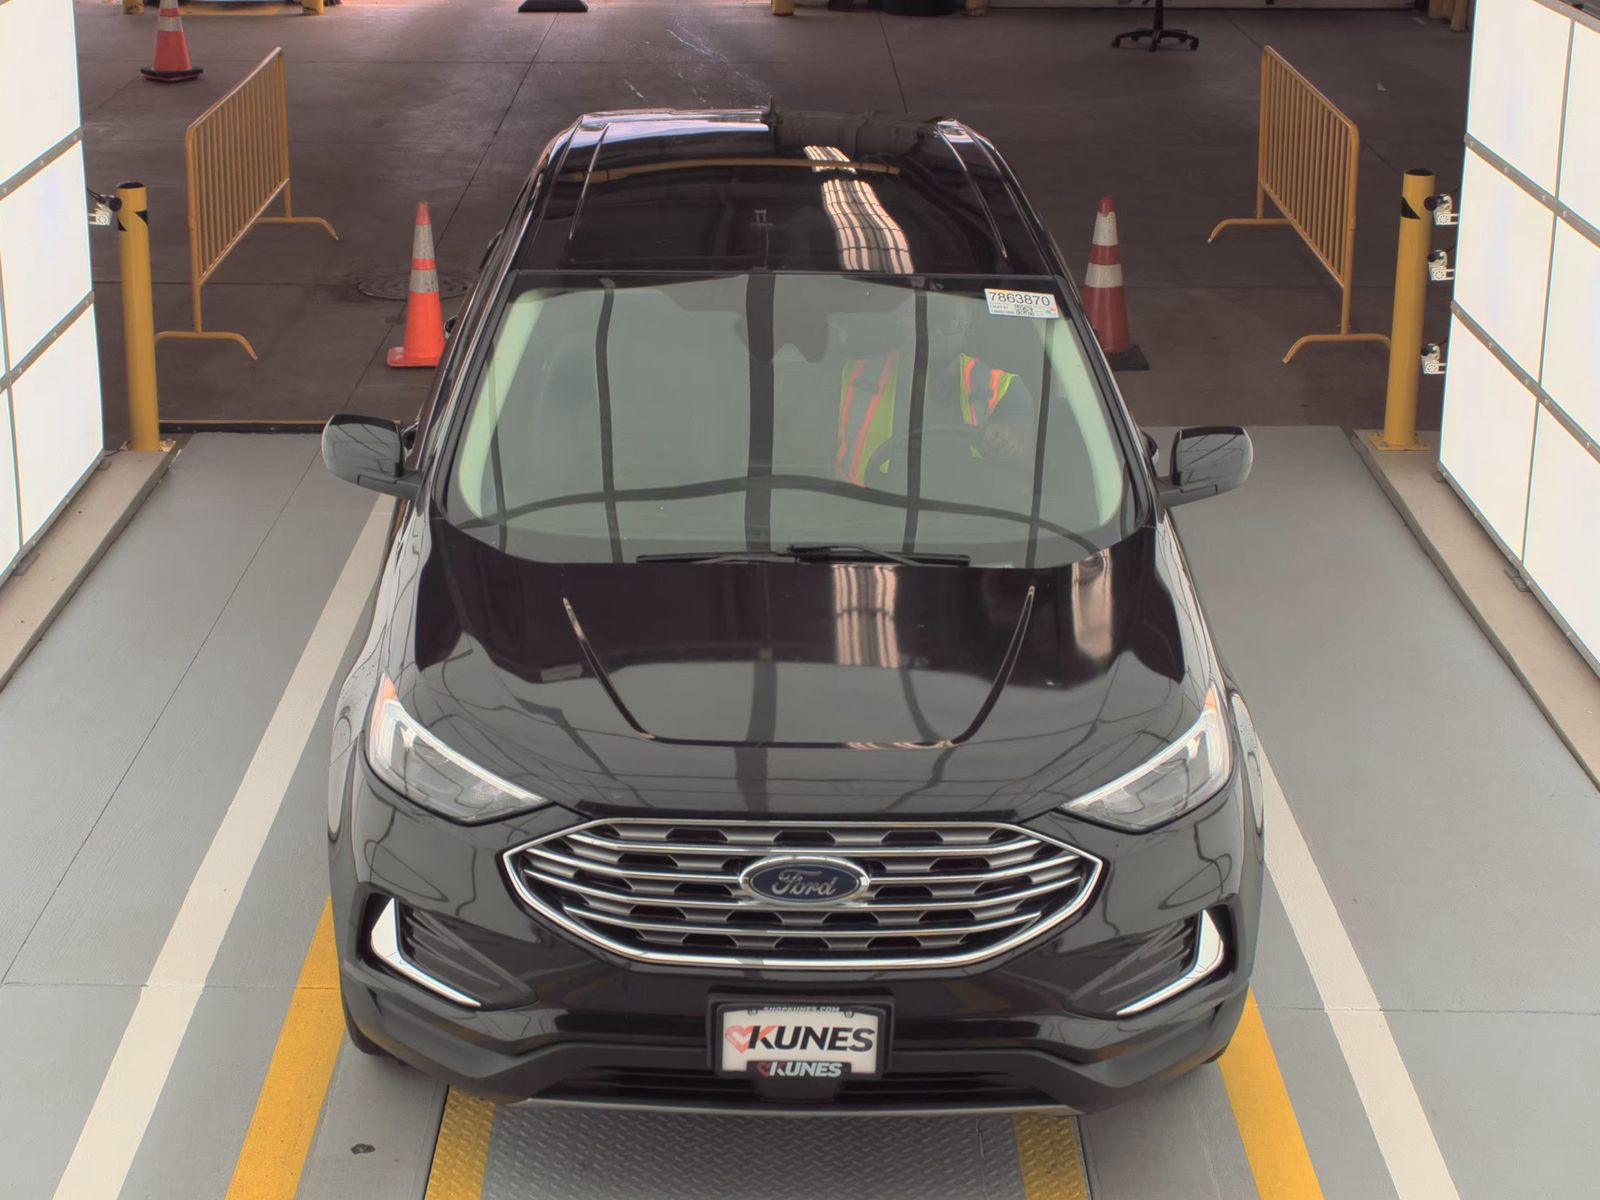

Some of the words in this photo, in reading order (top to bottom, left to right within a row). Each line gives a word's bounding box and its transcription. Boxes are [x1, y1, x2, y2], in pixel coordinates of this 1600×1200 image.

[988, 292, 1050, 306] 7863870
[772, 869, 839, 895] Ford
[748, 1025, 875, 1052] KUNES
[769, 1062, 843, 1077] KUNES
